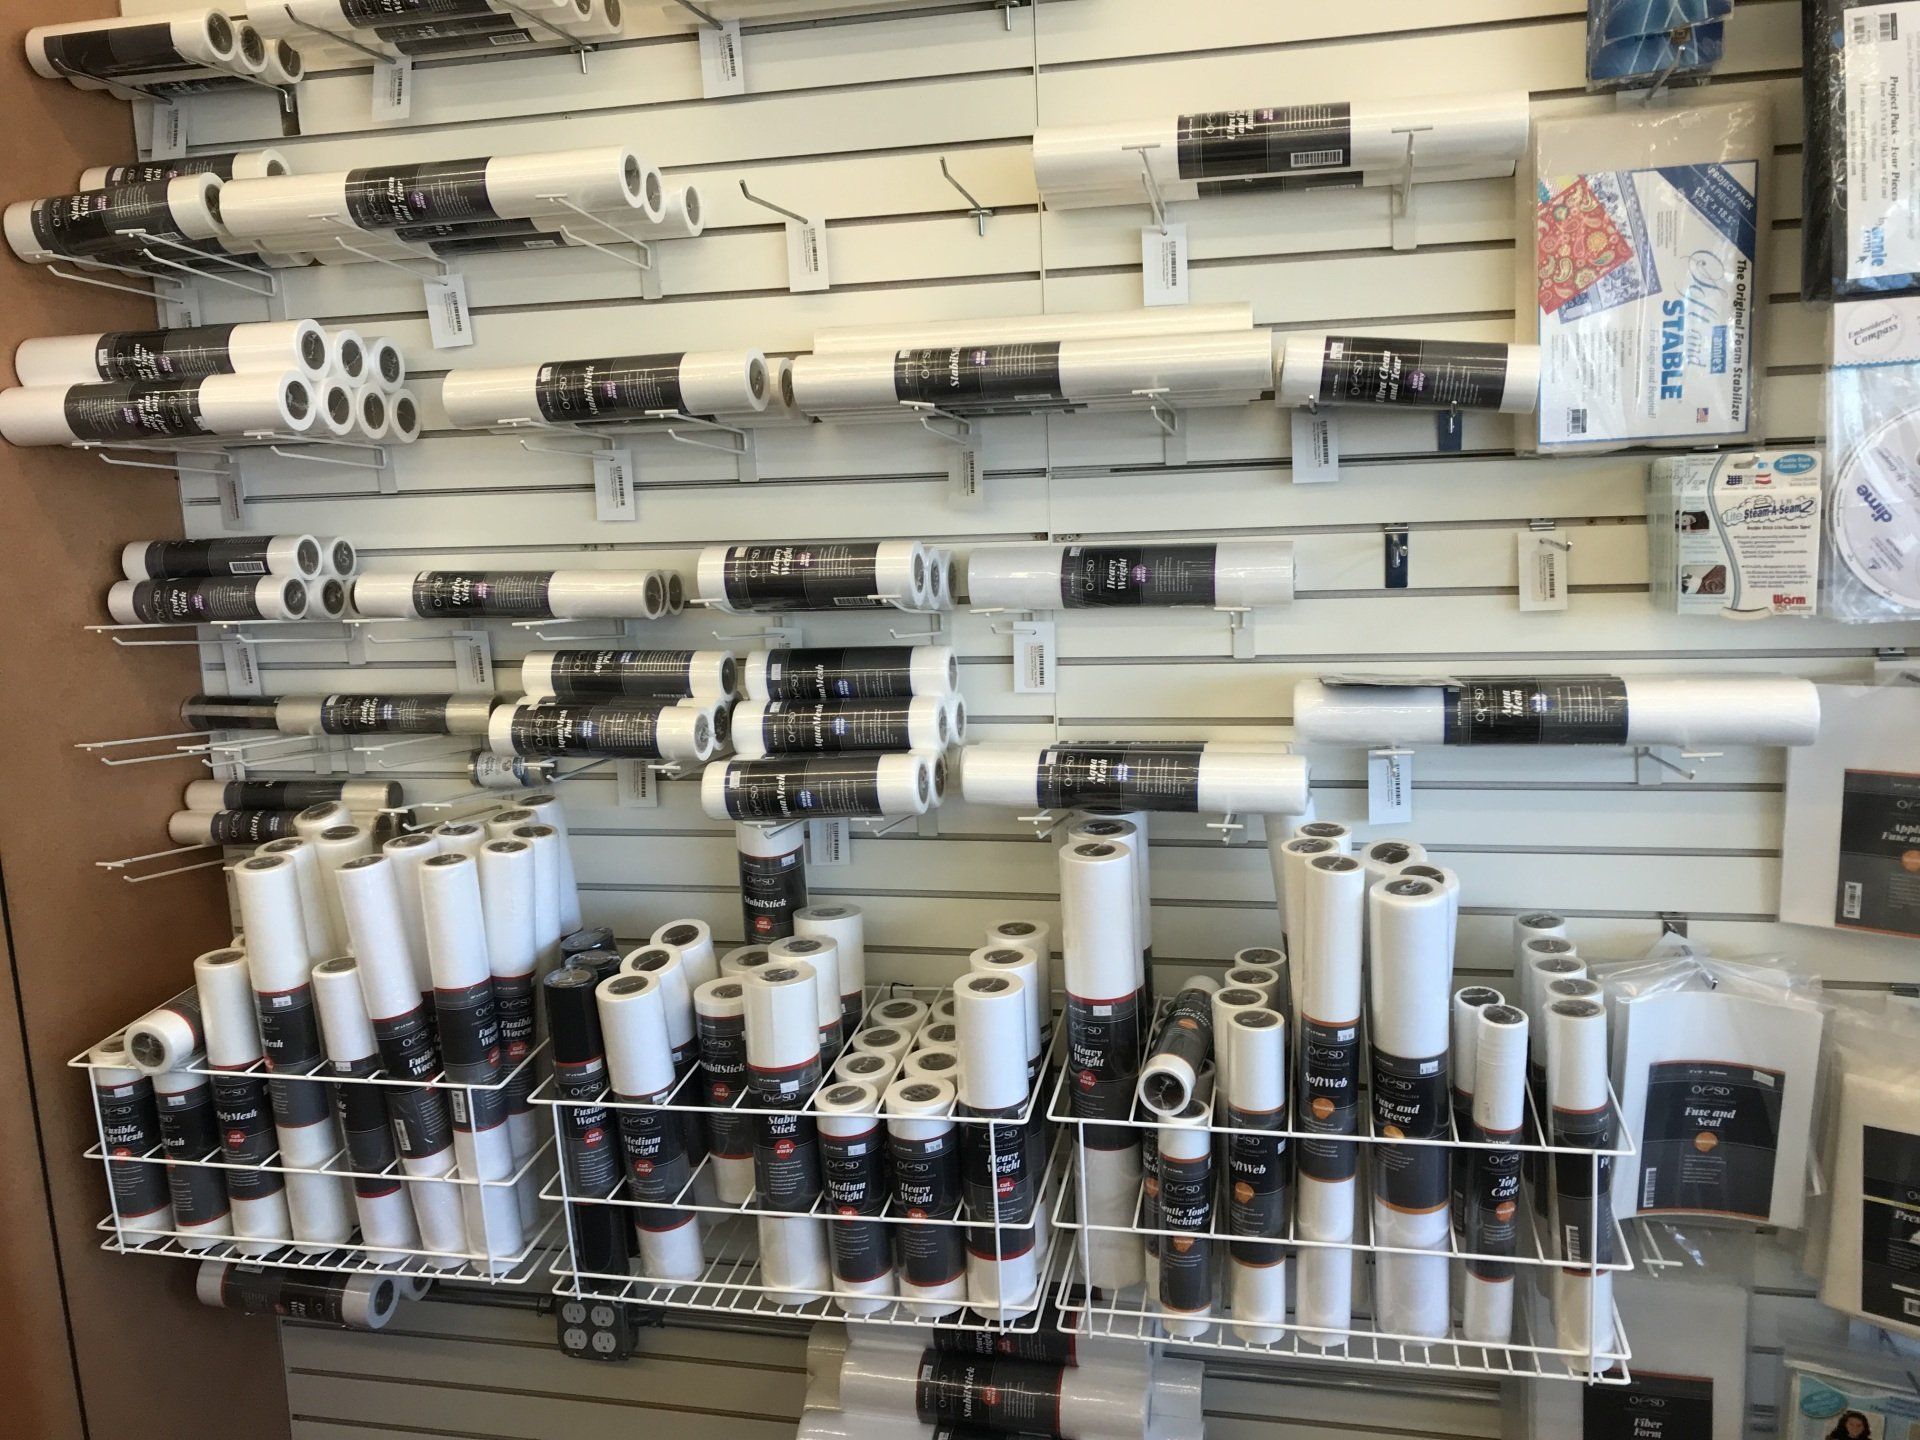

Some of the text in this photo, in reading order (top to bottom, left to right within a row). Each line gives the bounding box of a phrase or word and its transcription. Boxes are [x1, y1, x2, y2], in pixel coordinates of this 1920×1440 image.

[1889, 76, 1899, 106] Project
[1890, 110, 1900, 135] Pack
[388, 177, 398, 201] Clean
[1708, 166, 1754, 210] PROJECT PACK
[1891, 172, 1900, 201] Pieces
[1714, 187, 1736, 210] PIECES
[400, 203, 414, 222] and
[1871, 226, 1887, 267] annie
[1848, 313, 1898, 339] Embroiderer's
[1854, 323, 1898, 346] Compass
[1661, 300, 1685, 400] STABLE
[1731, 259, 1747, 422] The Original Foam Stabilizer
[148, 352, 160, 377] usible
[1375, 351, 1391, 403] Ultra Clean
[1388, 356, 1402, 400] and Tear
[1417, 373, 1426, 391] away
[583, 365, 601, 415] StabilStick
[1725, 513, 1743, 521] Lite
[1744, 503, 1800, 519] Steam-A-Seam
[1856, 484, 1892, 523] dime
[770, 548, 783, 575] Heavy
[781, 547, 794, 576] Weight
[1106, 559, 1116, 589] Heavy
[1117, 558, 1128, 590] Weight
[451, 577, 462, 605] Hydro
[462, 579, 471, 602] Stick
[1773, 594, 1806, 604] Warm
[169, 589, 182, 616] Hydro
[179, 591, 188, 613] Stick
[1501, 690, 1513, 717] Aqua
[1511, 690, 1523, 717] Mesh
[557, 709, 568, 749] AquaMesh
[565, 719, 573, 738] Plus
[813, 704, 824, 749] AquaMesh
[1086, 758, 1098, 784] Aqua
[1097, 758, 1108, 784] Mesh
[744, 895, 787, 908] StabilStick
[500, 1017, 532, 1029] Fusible
[502, 1027, 532, 1038] Woven
[1074, 1043, 1102, 1057] Heavy
[1074, 1052, 1104, 1068] Weight
[1305, 1072, 1348, 1088] SoftWeb
[217, 1109, 258, 1121] PolyMesh
[1375, 1093, 1421, 1115] Fuse and
[1684, 1106, 1737, 1119] Fuse and
[575, 1111, 607, 1126] Woven
[767, 1115, 797, 1125] Stabil
[1379, 1108, 1412, 1124] Fleece
[1697, 1117, 1721, 1127] Seal
[624, 1135, 661, 1145] Medium
[770, 1123, 796, 1135] Stick
[628, 1144, 659, 1156] Weight
[828, 1179, 866, 1191] Medium
[901, 1182, 931, 1194] Heavy
[1498, 1176, 1517, 1188] Top
[831, 1190, 864, 1203] Weight
[901, 1191, 933, 1204] Weight
[1186, 1202, 1210, 1216] Touch
[1166, 1214, 1202, 1227] Backing
[963, 1366, 976, 1418] StabilStick
[1634, 1417, 1663, 1429] Fiber
[1634, 1427, 1662, 1439] Form
